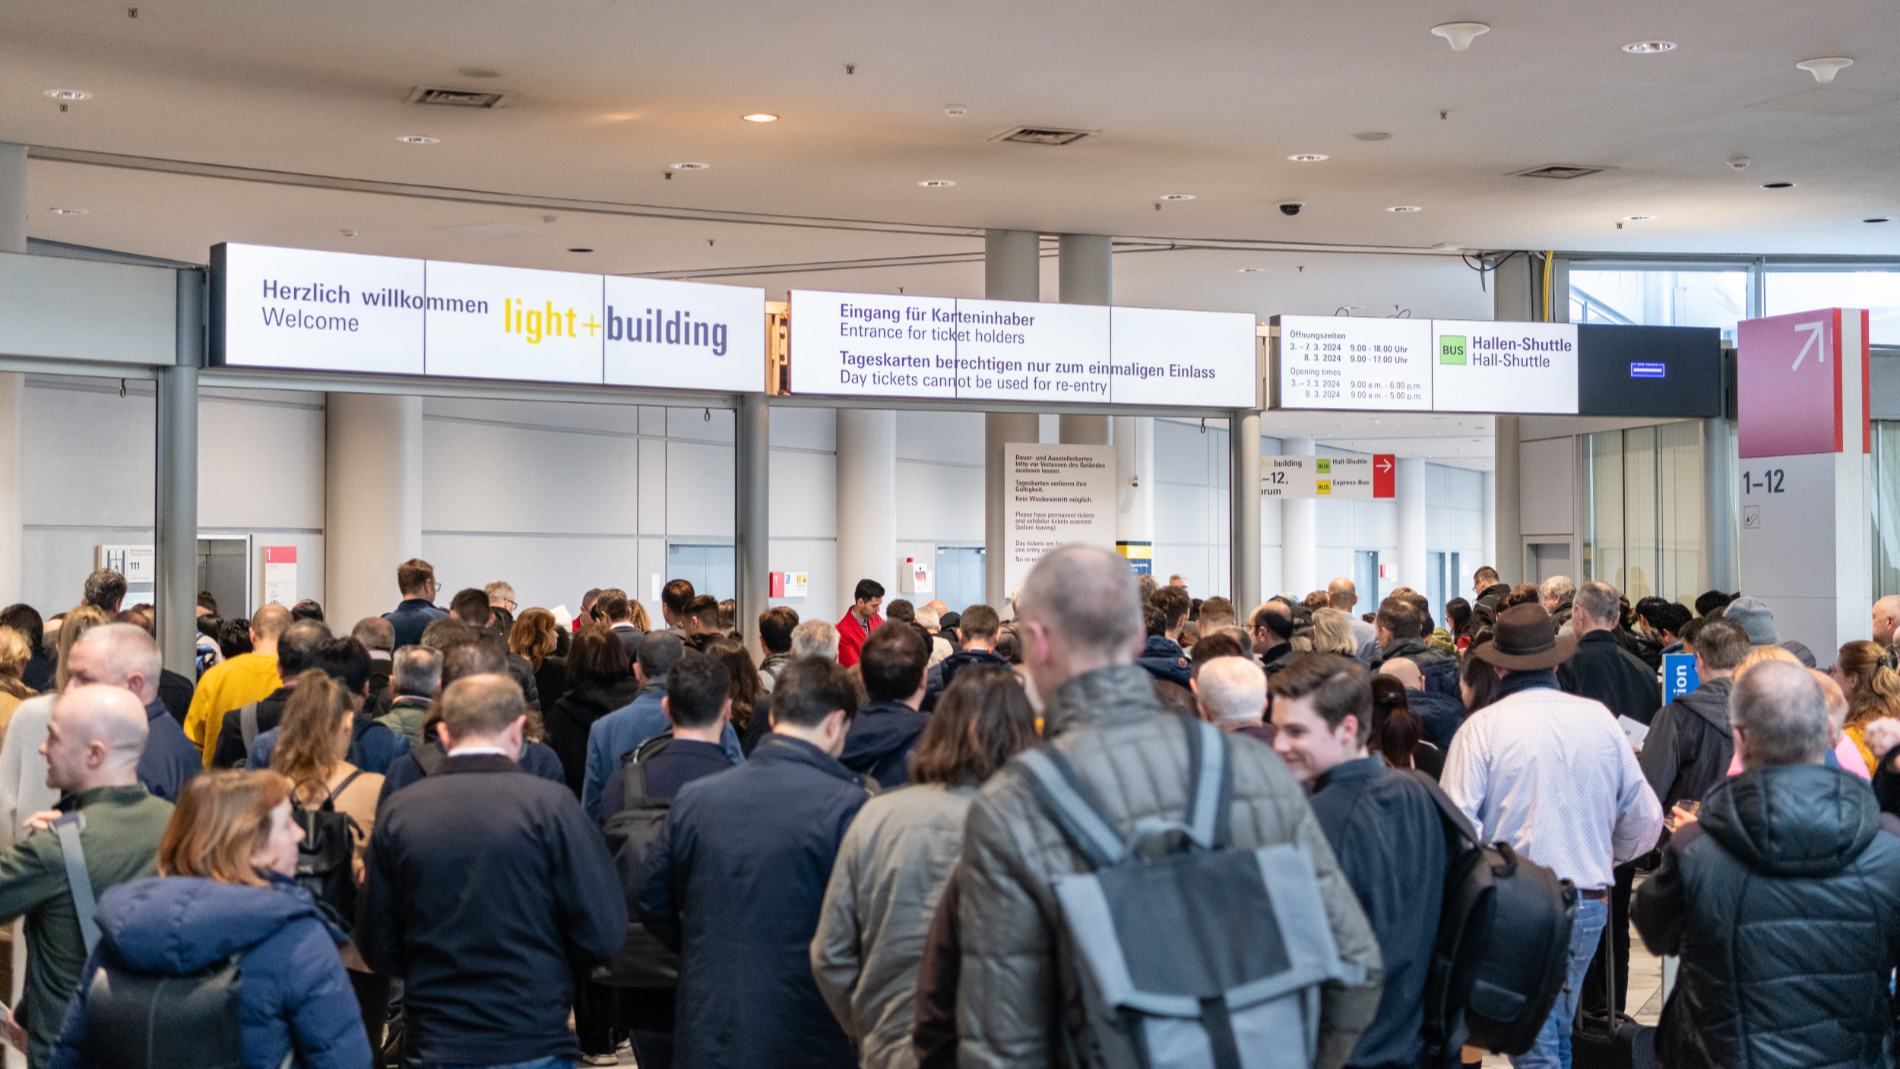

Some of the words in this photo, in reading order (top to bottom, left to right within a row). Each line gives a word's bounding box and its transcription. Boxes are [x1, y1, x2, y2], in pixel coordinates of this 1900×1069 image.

[262, 278, 350, 305] Herzlich
[362, 289, 488, 314] willkommen
[262, 306, 359, 332] Welcome
[840, 303, 900, 322] Eingang
[905, 307, 926, 322] für
[932, 308, 1035, 327] Karteninhaber
[840, 323, 903, 340] Entrance
[908, 325, 926, 339] for
[932, 326, 969, 342] ticket
[975, 329, 1024, 344] holders
[1290, 329, 1346, 340] Öffnungszeiten
[1395, 345, 1408, 353] Uhr
[1442, 345, 1463, 355] BUS
[1473, 336, 1572, 352] Hallen-Shuttle
[840, 350, 930, 371] Tageskarten
[936, 354, 1022, 374] berechtigen
[1028, 362, 1050, 372] nur
[1055, 363, 1083, 374] zum
[1089, 360, 1165, 379] einmaligen
[1170, 364, 1215, 379] Einlass
[1473, 353, 1550, 368] Hall-Shuttle
[1290, 367, 1319, 377] Opening
[1322, 368, 1341, 376] times
[840, 370, 867, 388] Day
[872, 372, 917, 387] tickets
[923, 373, 971, 388] cannot
[976, 374, 992, 390] be
[998, 375, 1028, 390] used
[1033, 377, 1051, 390] for
[1056, 381, 1107, 395] re-entry
[268, 549, 271, 561] 1
[1673, 665, 1687, 695] ion
